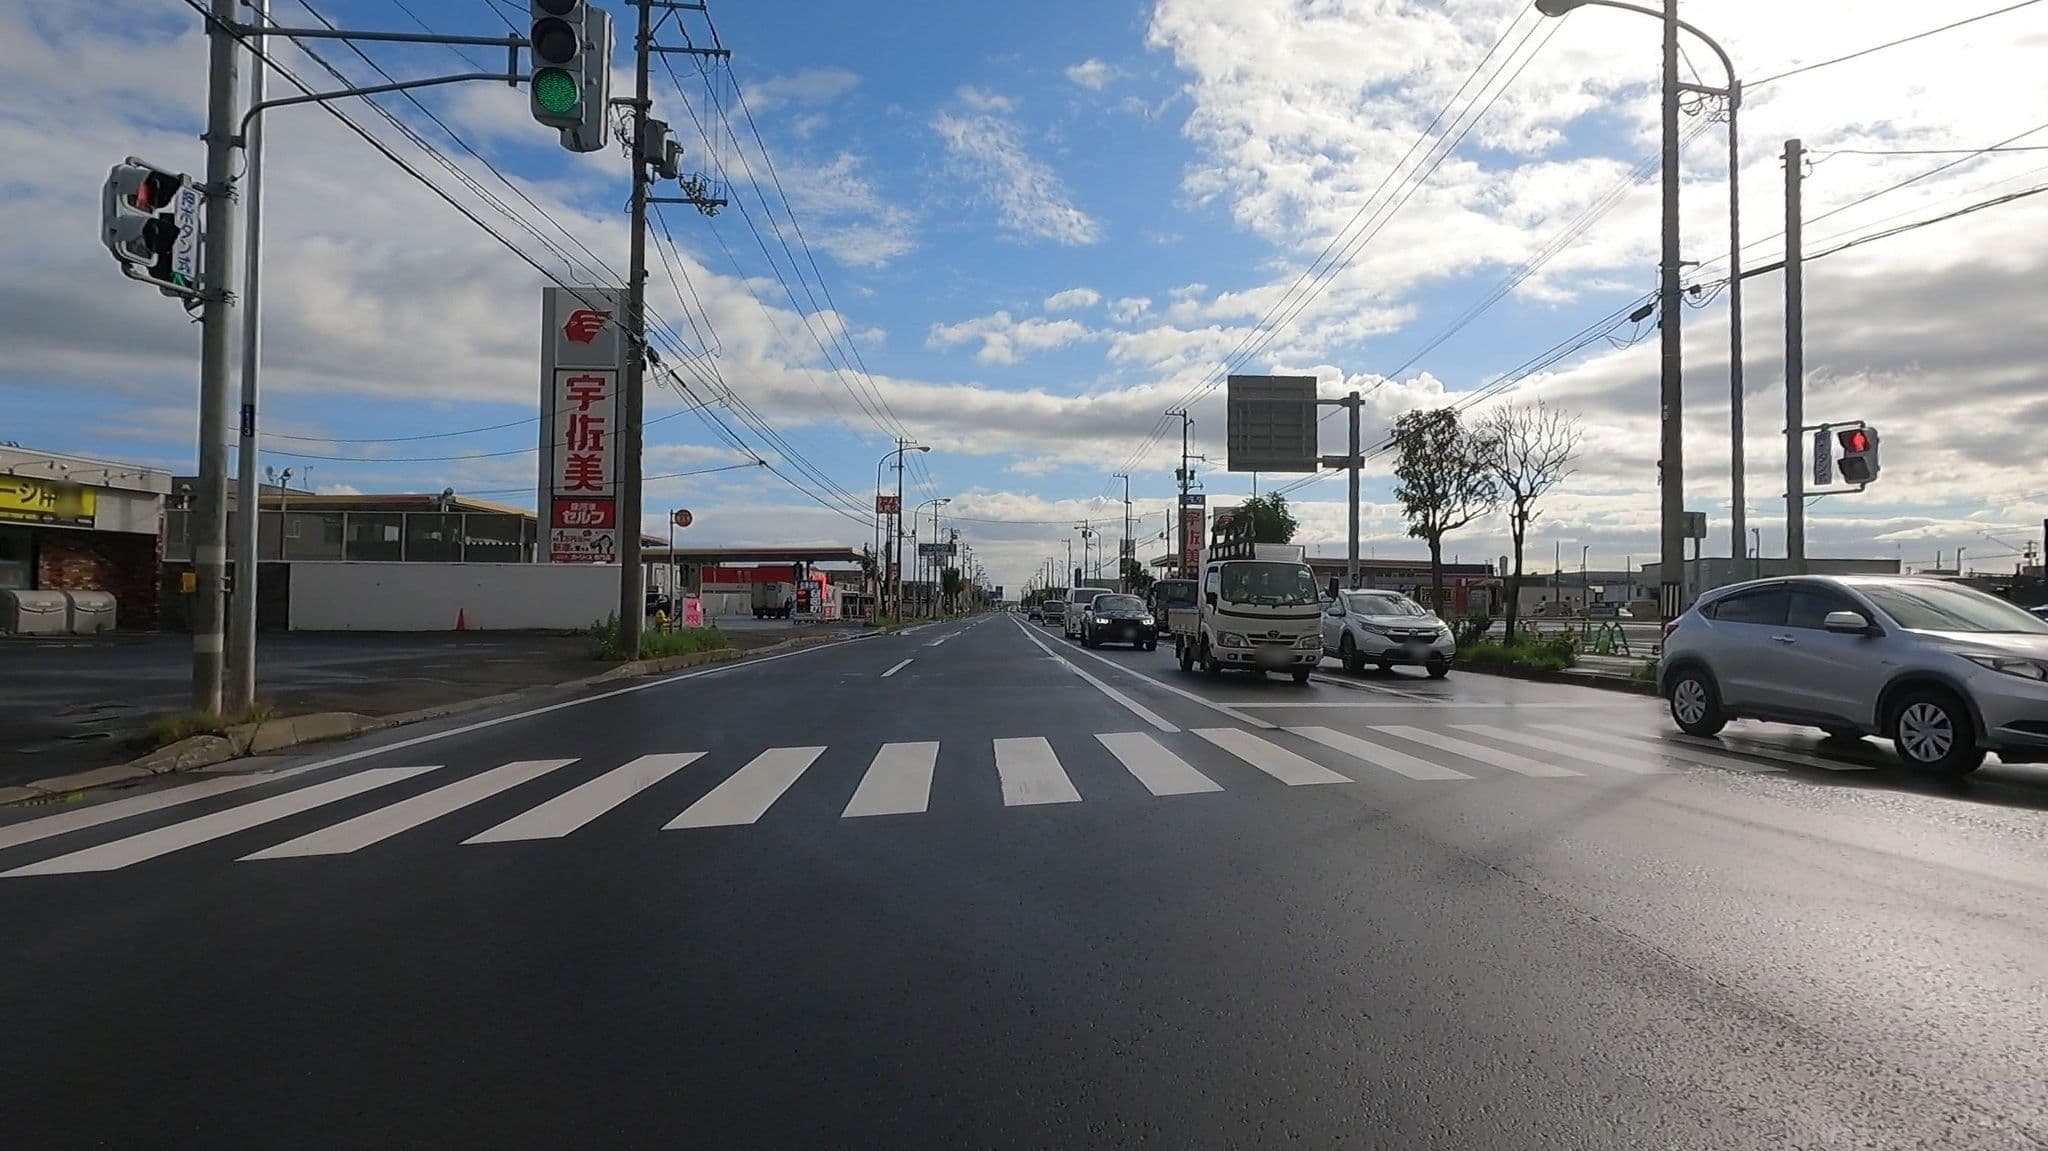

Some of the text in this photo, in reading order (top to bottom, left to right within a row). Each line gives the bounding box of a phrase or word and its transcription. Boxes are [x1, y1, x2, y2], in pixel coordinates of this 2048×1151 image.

[564, 375, 605, 491] 宇佐美
[562, 510, 605, 524] セルフ
